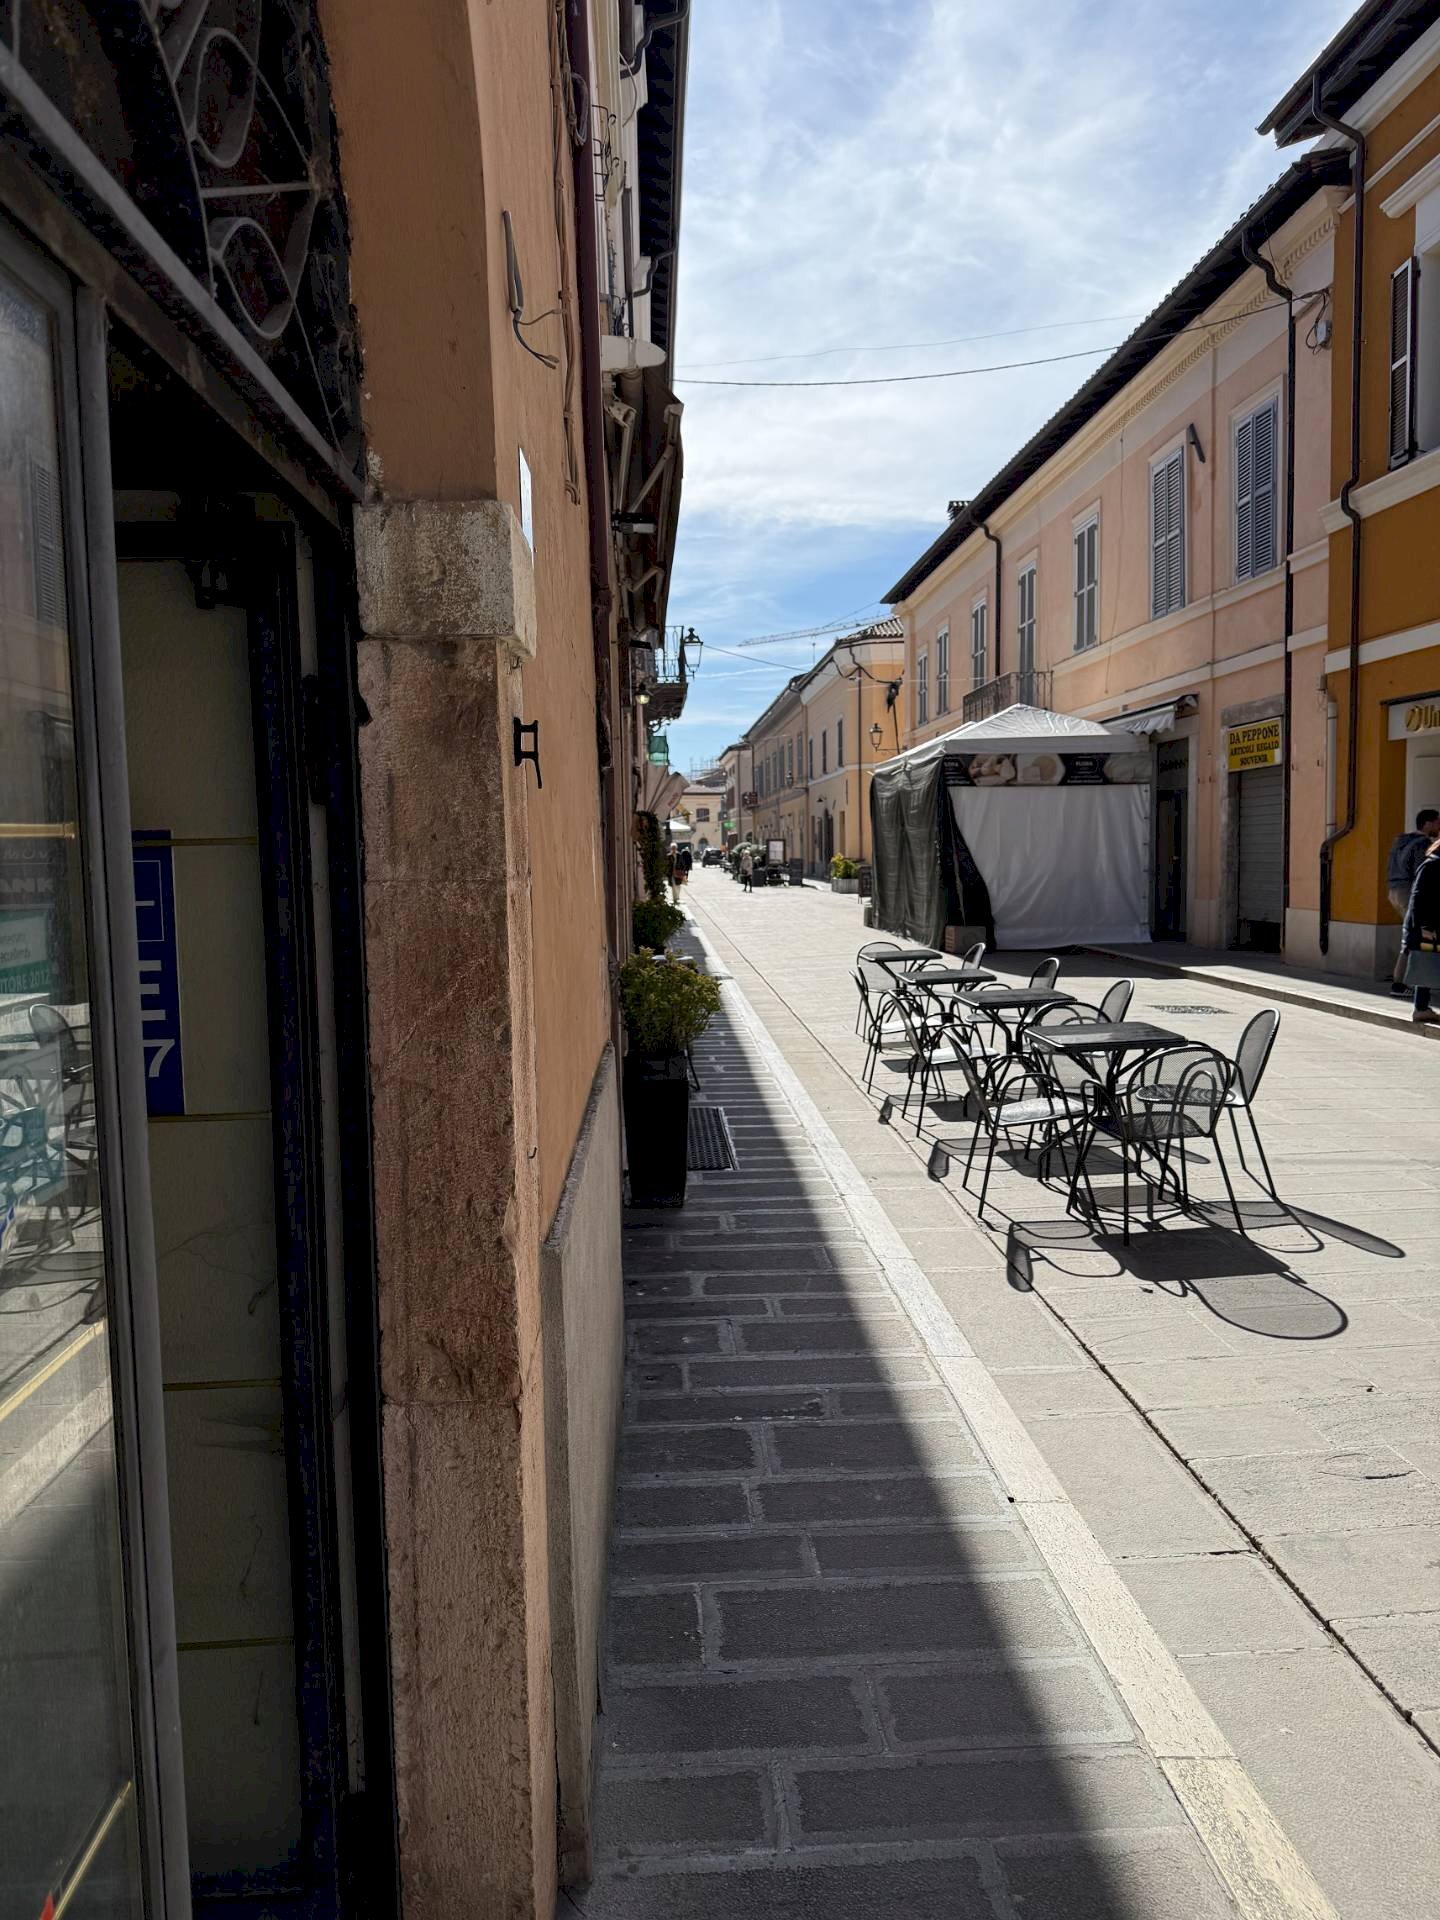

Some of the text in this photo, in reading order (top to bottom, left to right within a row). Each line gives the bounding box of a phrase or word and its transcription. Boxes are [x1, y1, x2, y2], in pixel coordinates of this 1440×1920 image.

[1230, 724, 1279, 744] DA PEPPONE
[1231, 740, 1280, 756] ARTICOLI REGALO
[1240, 754, 1267, 766] SOUVENIR
